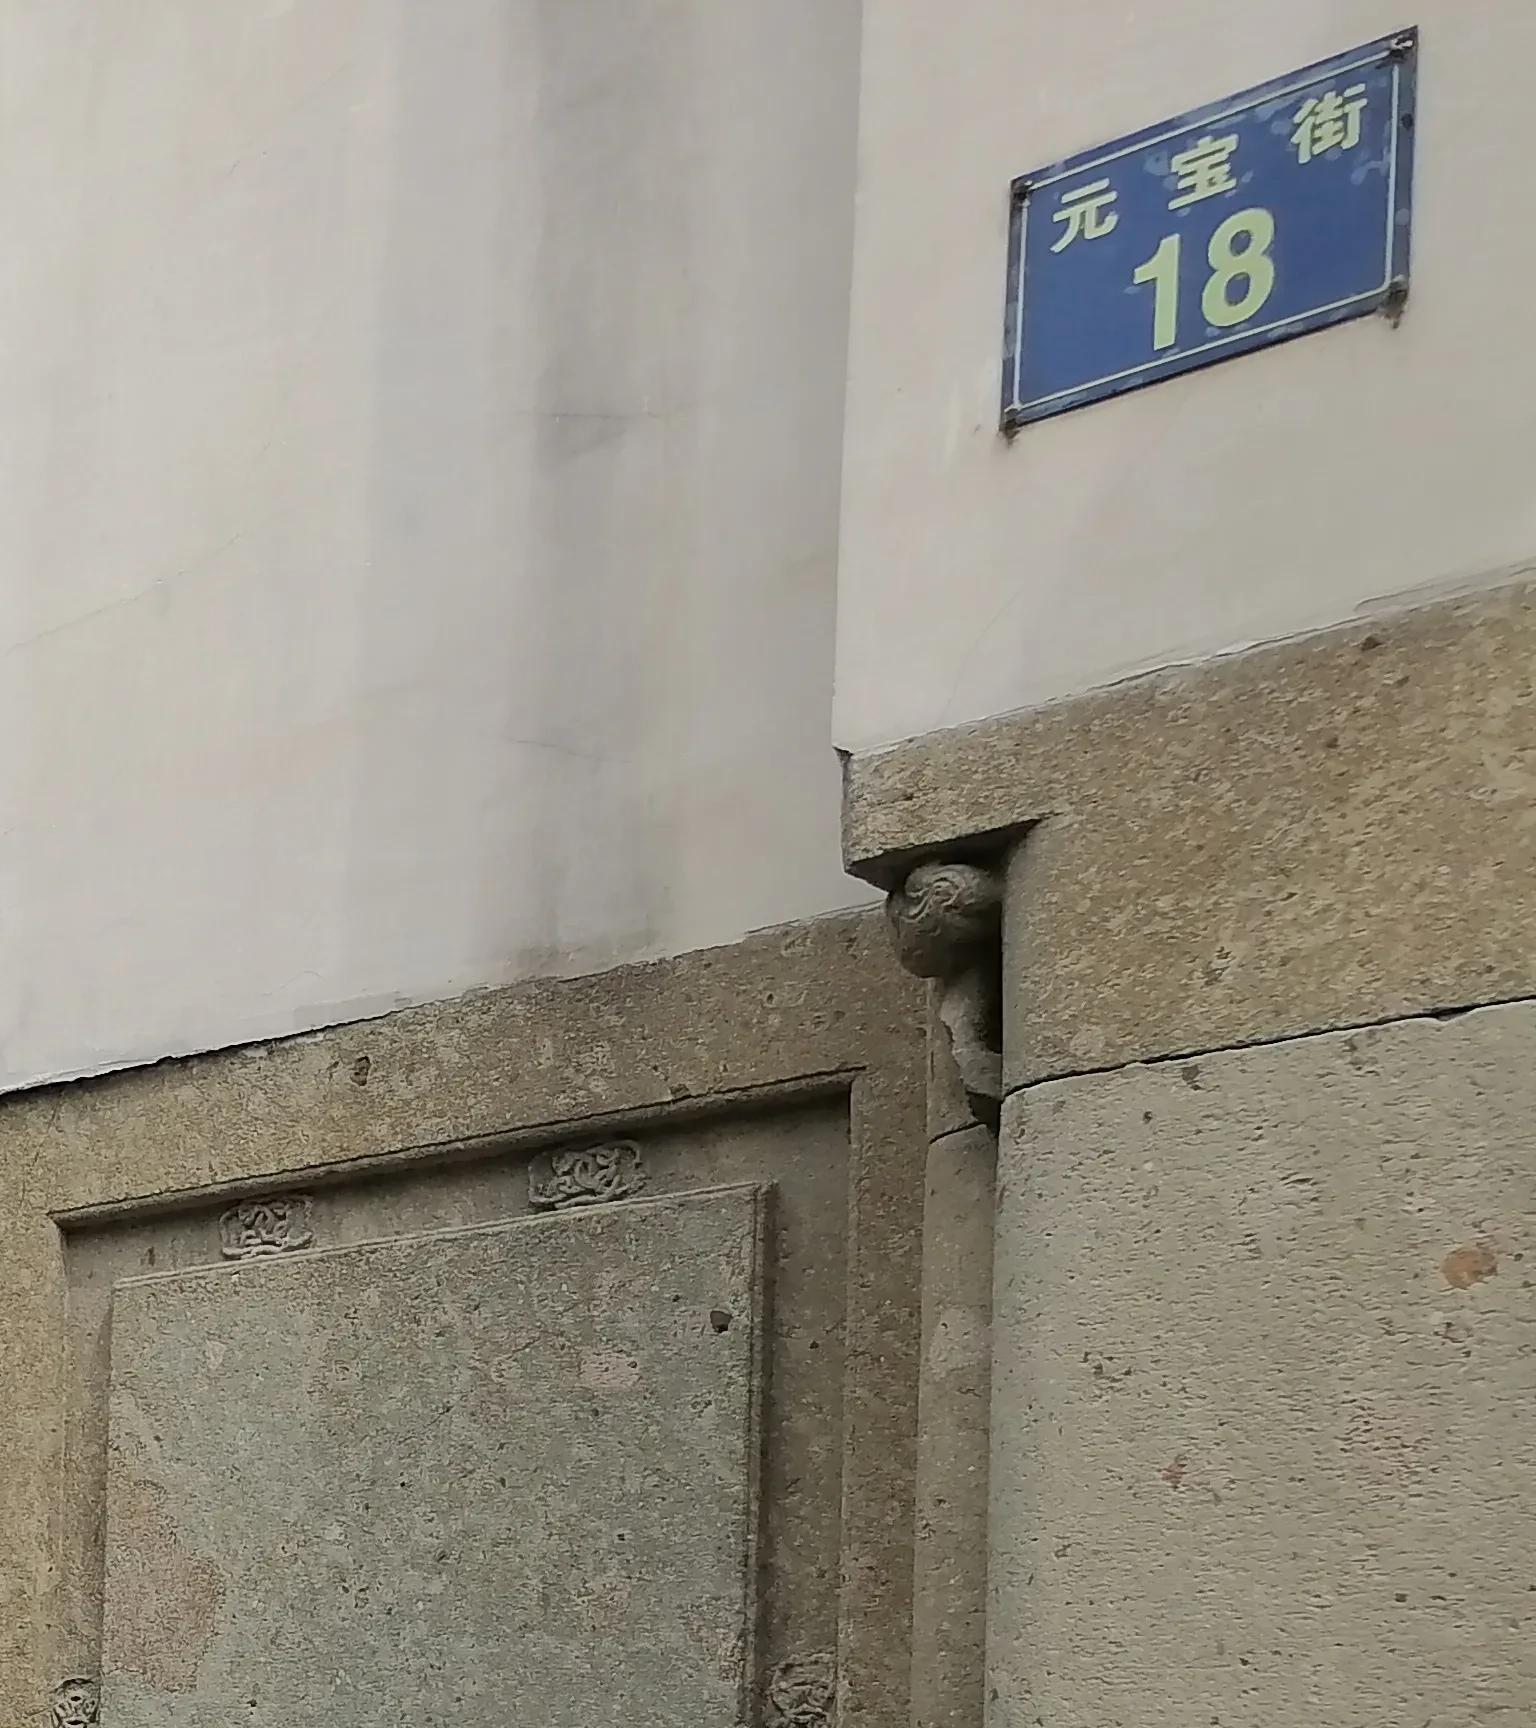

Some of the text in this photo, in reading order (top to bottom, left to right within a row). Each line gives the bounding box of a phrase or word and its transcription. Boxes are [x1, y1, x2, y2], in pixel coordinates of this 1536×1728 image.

[1050, 83, 1367, 253] 元宝街
[1133, 207, 1275, 351] 18
